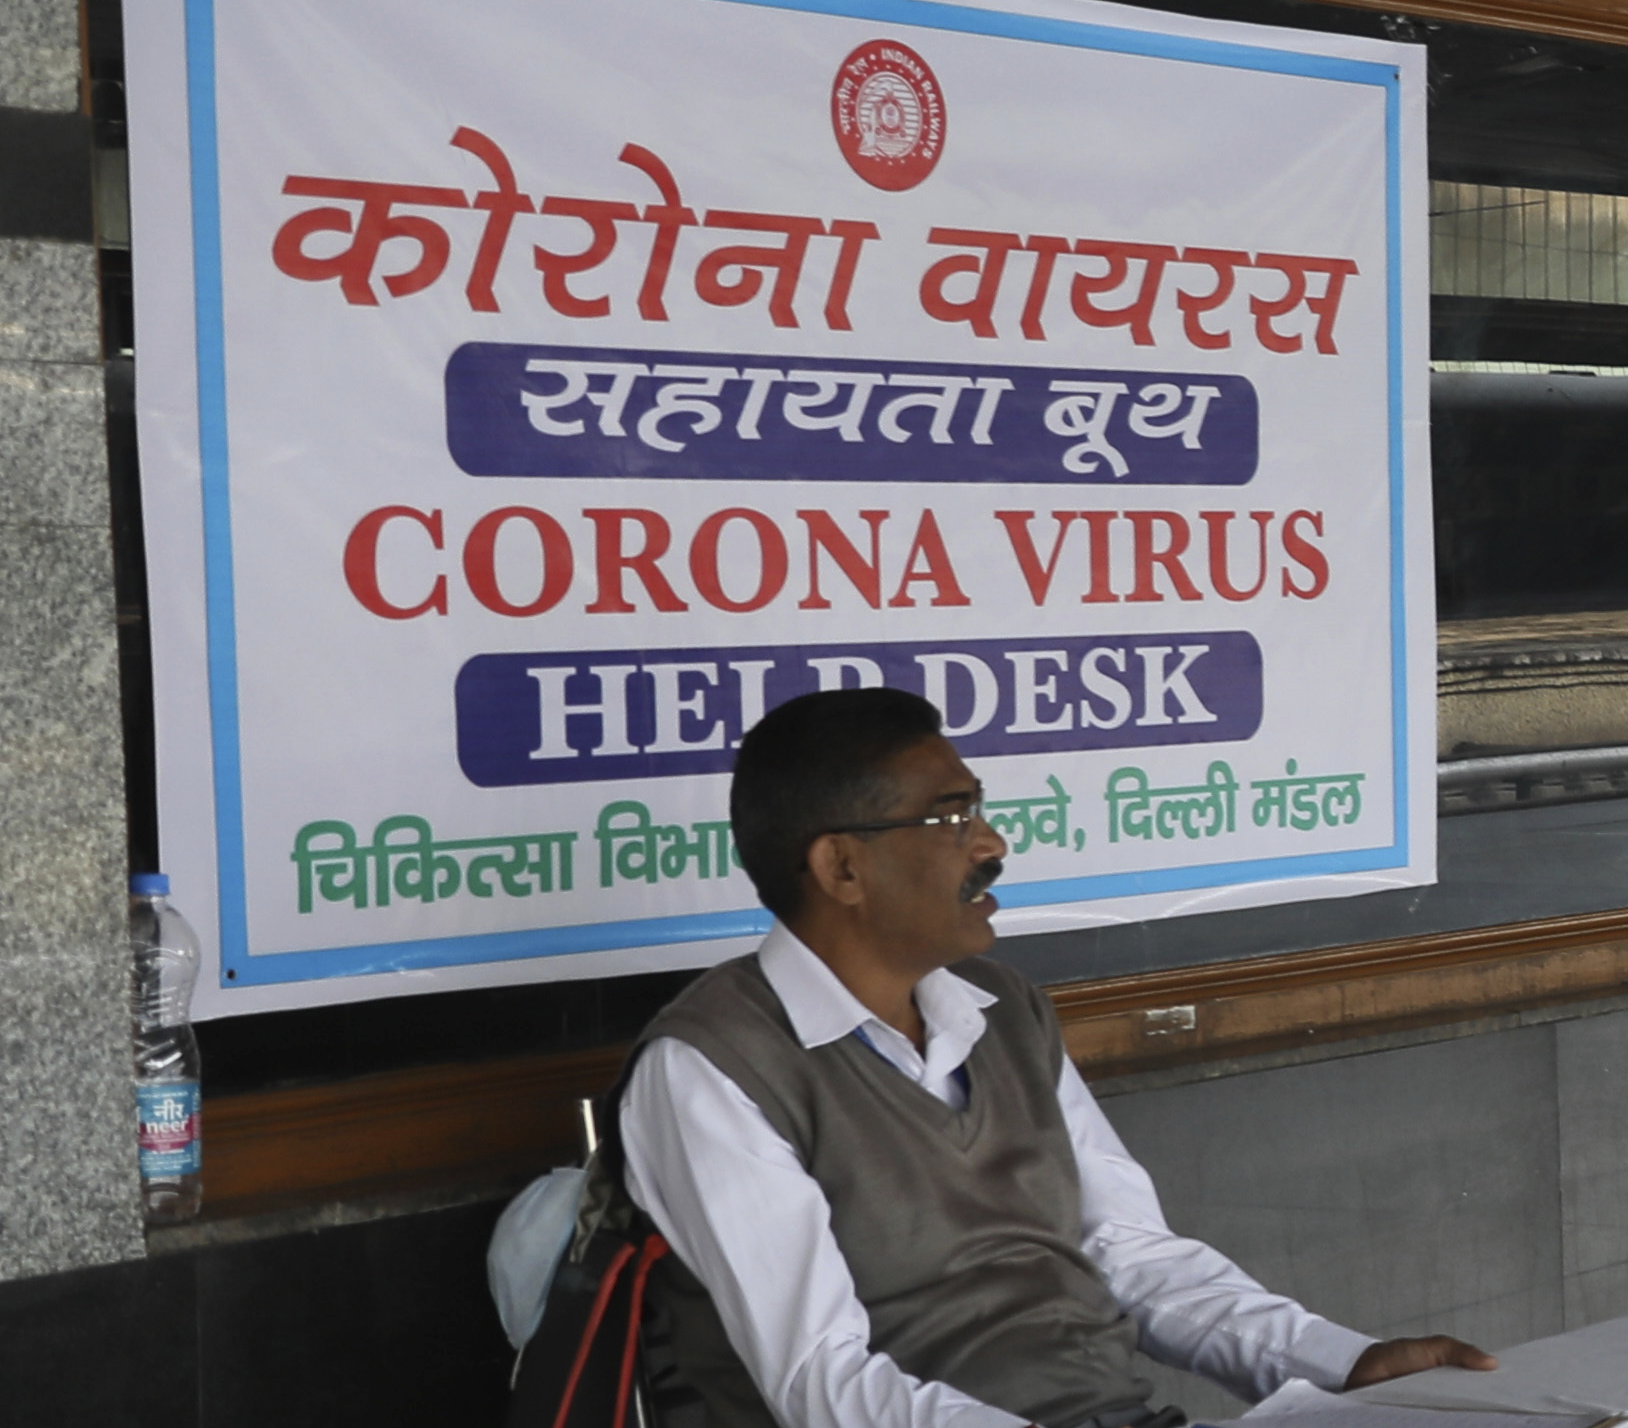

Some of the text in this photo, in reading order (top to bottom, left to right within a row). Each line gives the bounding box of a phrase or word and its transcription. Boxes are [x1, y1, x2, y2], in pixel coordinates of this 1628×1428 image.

[273, 126, 1357, 354] कोरोना वायरस
[521, 358, 1223, 477] सहायता बूथ
[344, 506, 1328, 619] CORONA VIRUS
[914, 645, 1217, 737] DESK
[291, 815, 578, 913] चिकित्सा
[985, 774, 1086, 854] लवे,
[1104, 760, 1239, 843] दिल्ली
[1250, 758, 1366, 831] मंडल
